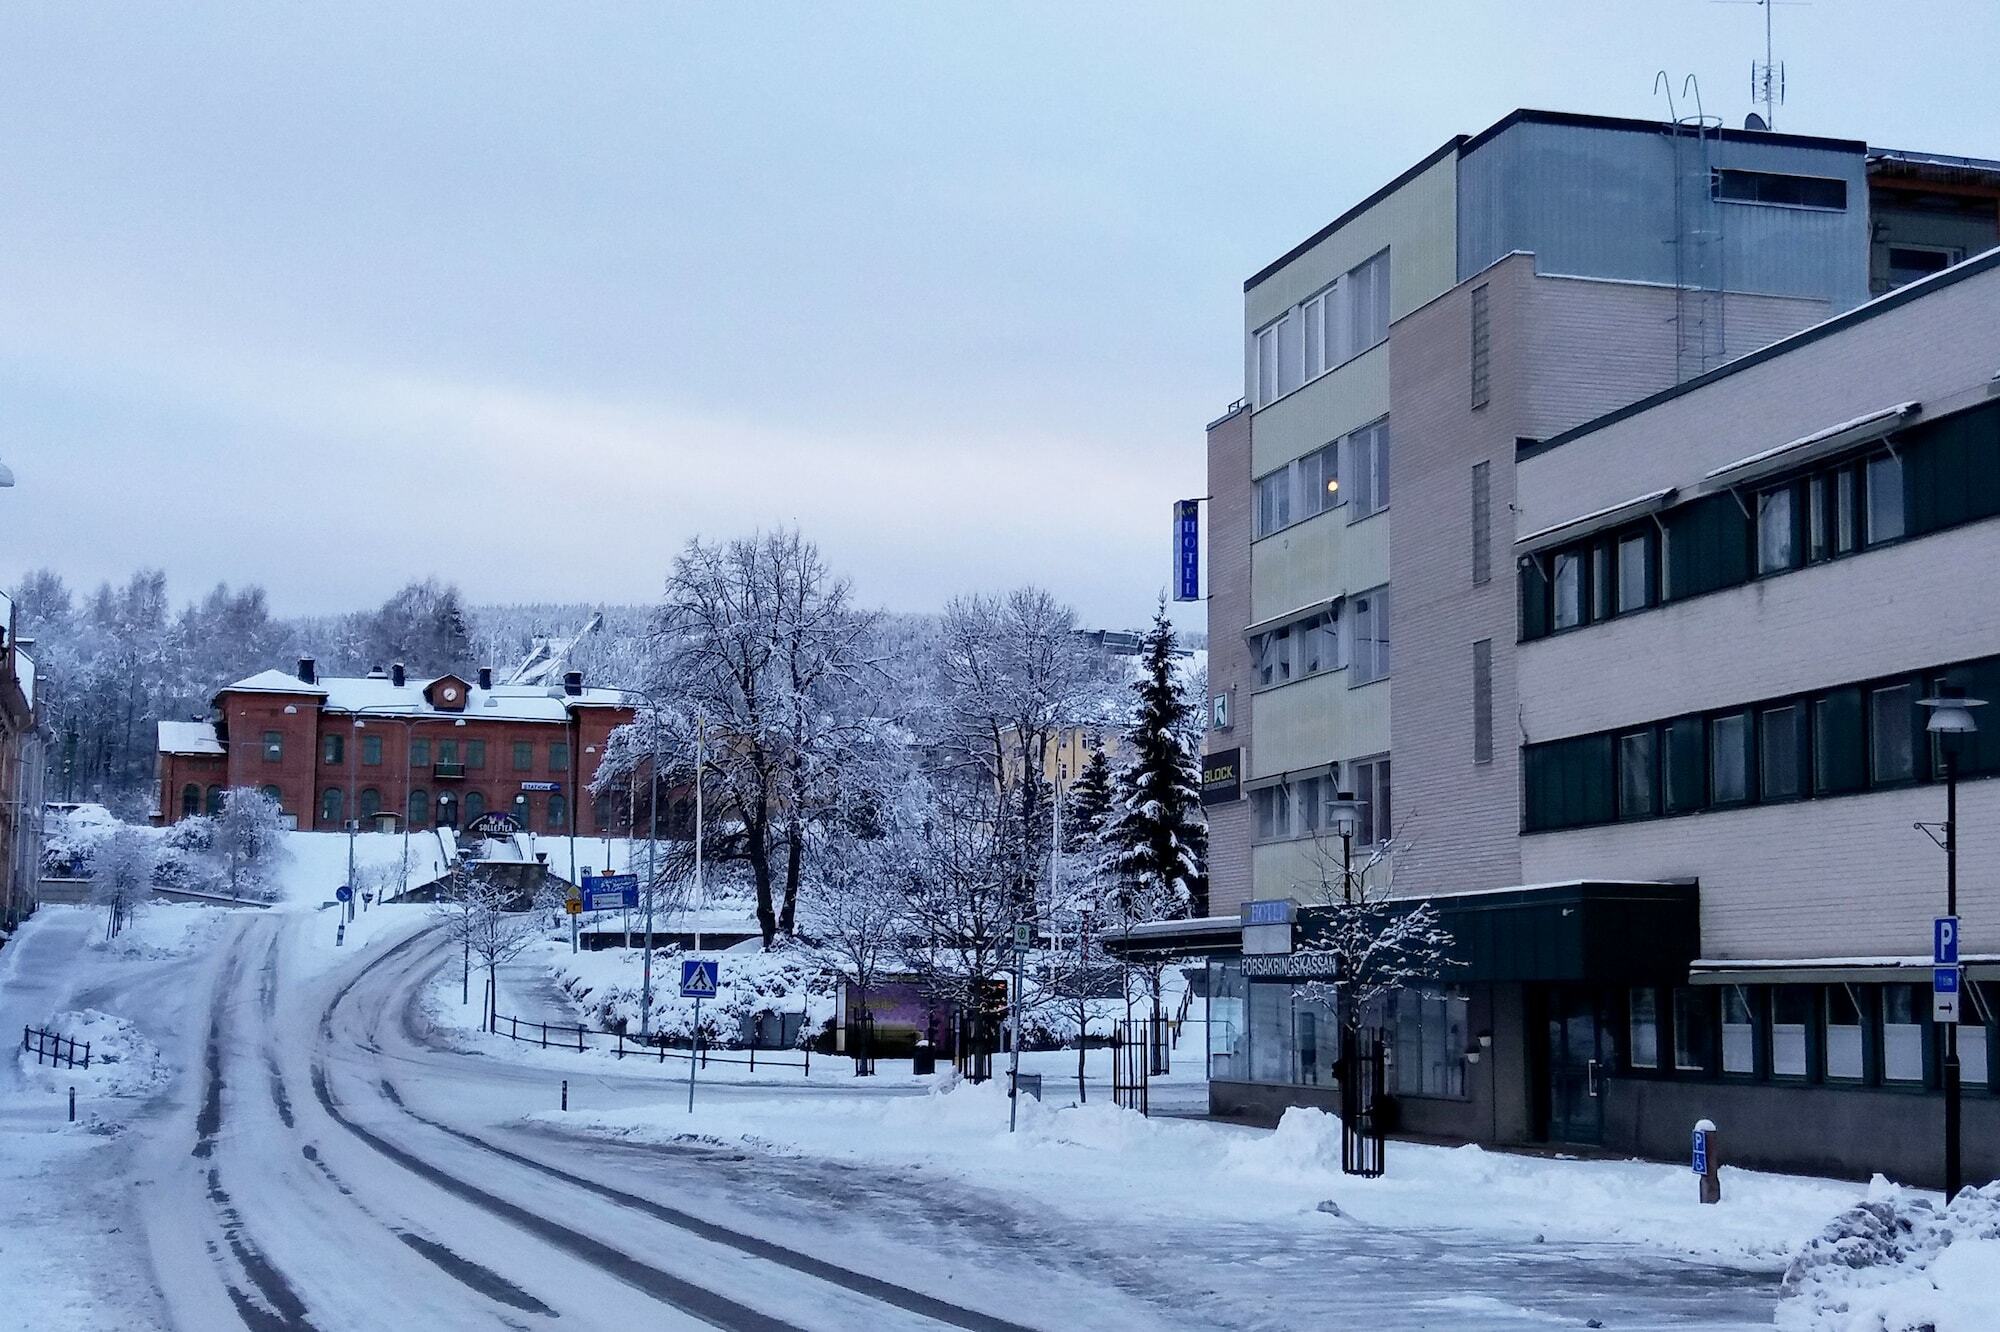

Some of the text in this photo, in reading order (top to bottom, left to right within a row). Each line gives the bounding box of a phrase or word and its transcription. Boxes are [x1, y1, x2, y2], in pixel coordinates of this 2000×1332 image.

[1203, 765, 1233, 784] BLOCK
[1941, 922, 1953, 961] P
[1241, 957, 1336, 976] FÖRSÄKRINGSKASSAN
[1695, 1133, 1702, 1150] P
